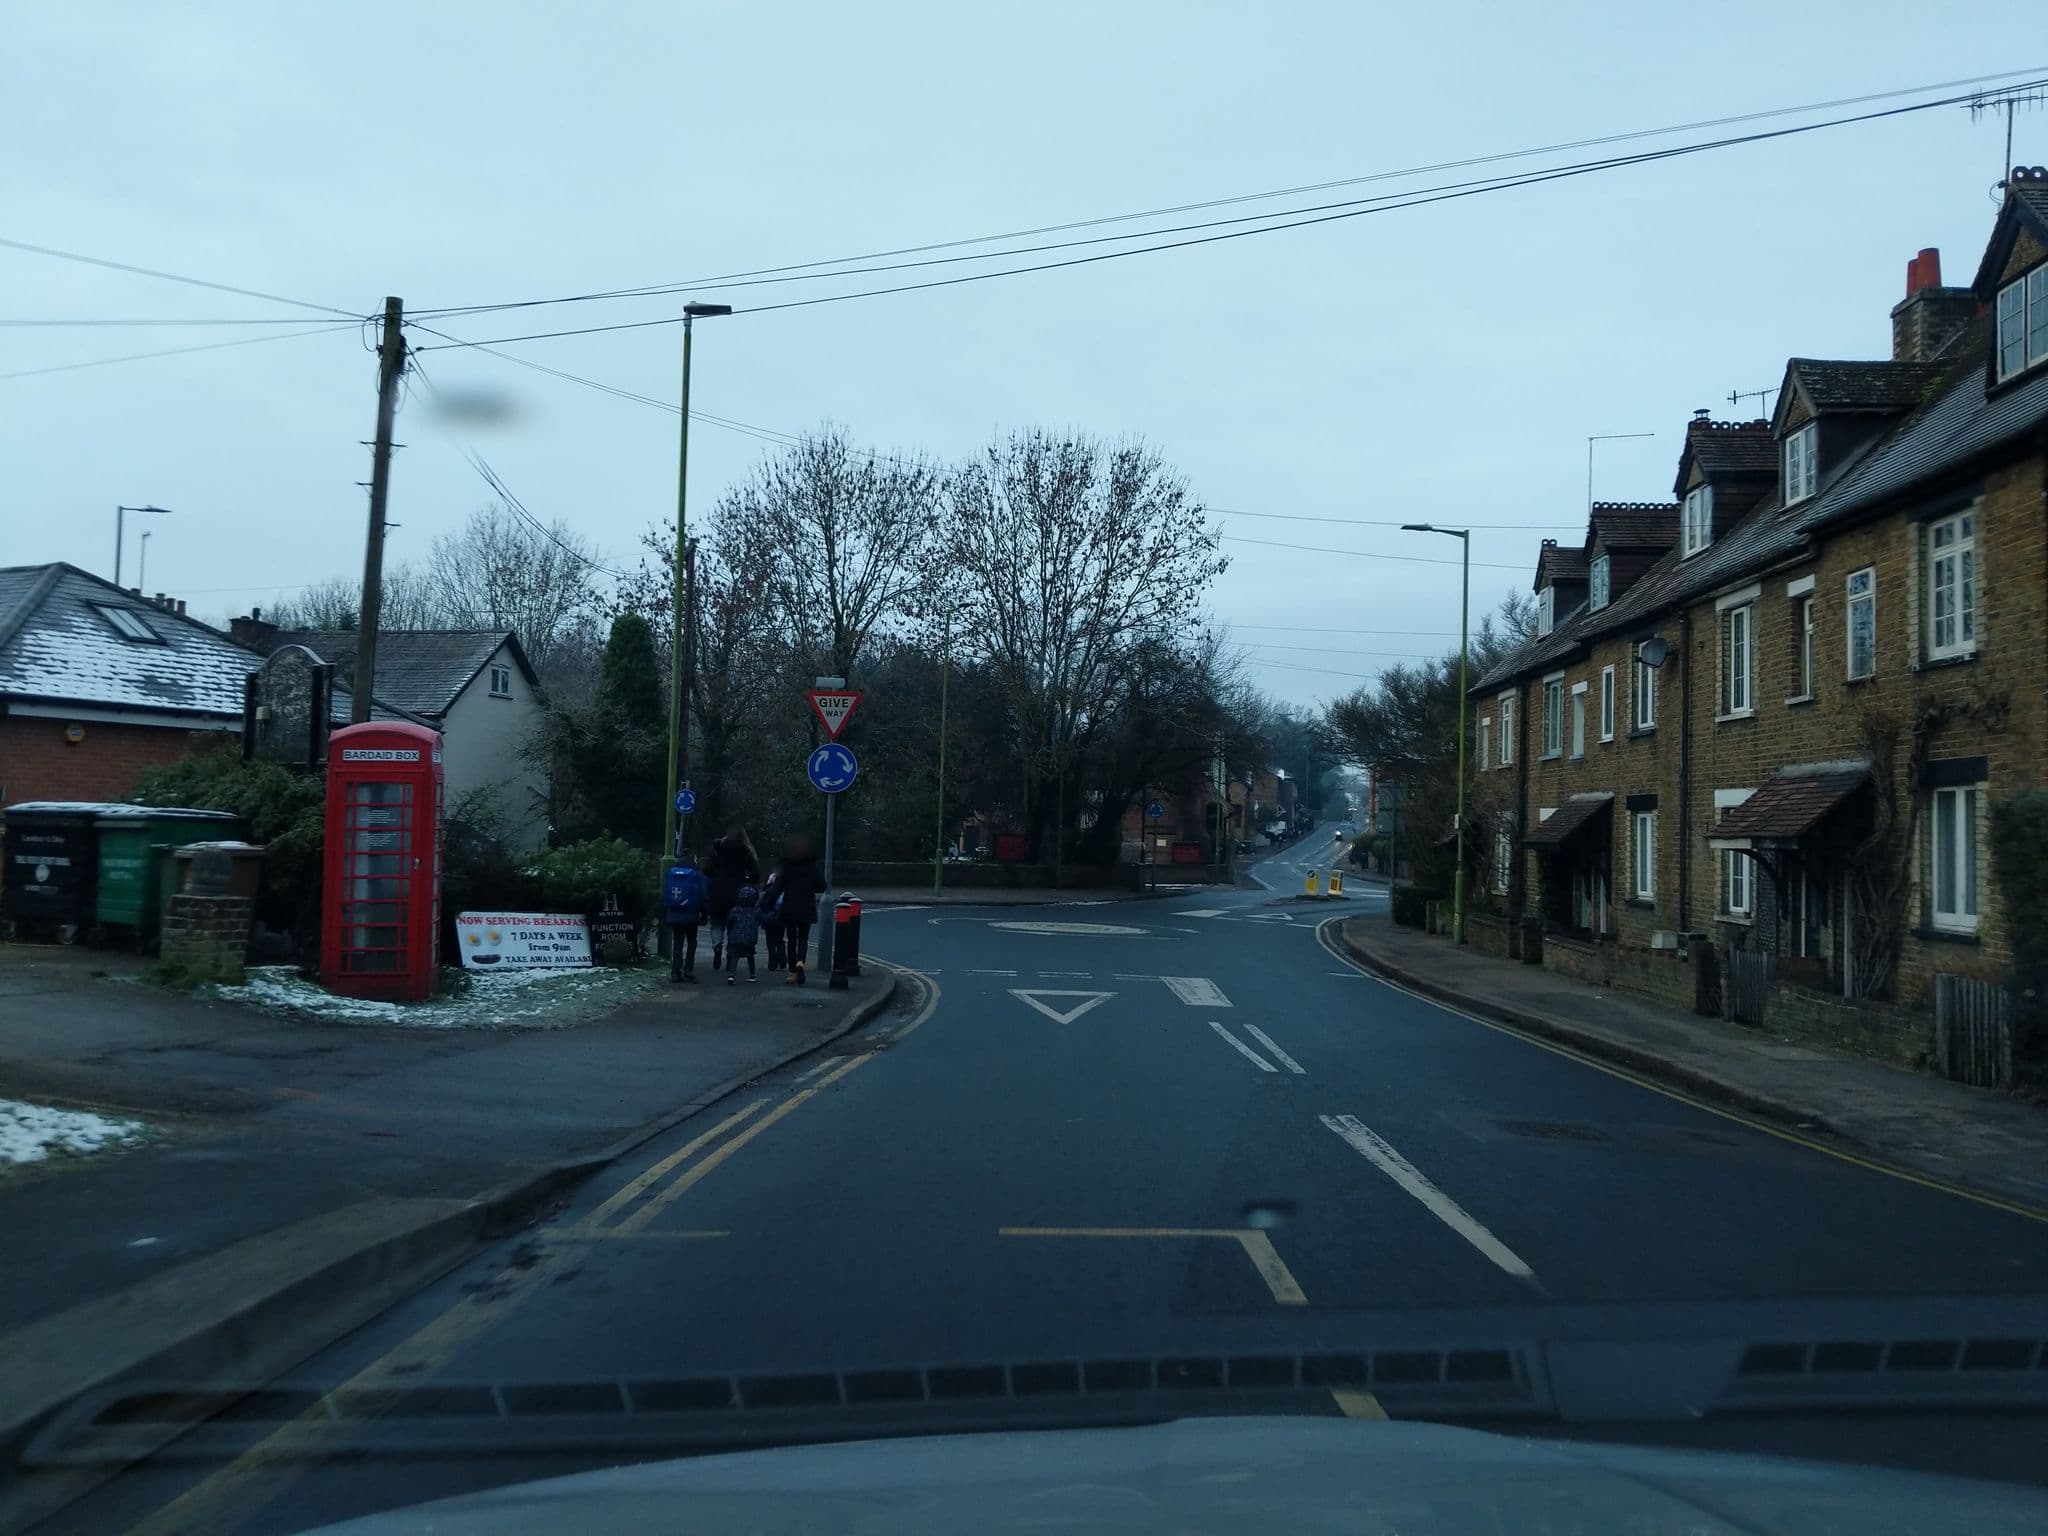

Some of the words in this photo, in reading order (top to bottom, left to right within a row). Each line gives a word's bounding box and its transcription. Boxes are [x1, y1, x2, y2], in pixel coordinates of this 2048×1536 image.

[819, 698, 849, 708] GIVE
[344, 751, 393, 760] BARDAID
[396, 751, 419, 760] BOX
[458, 916, 483, 925] NOW
[486, 917, 531, 926] SERVING
[591, 923, 634, 932] FUNCTION
[510, 932, 517, 941] 7
[520, 931, 546, 940] DAYS
[548, 932, 556, 940] A
[557, 932, 584, 940] WEEK
[528, 943, 550, 951] from
[552, 943, 572, 952] 9am
